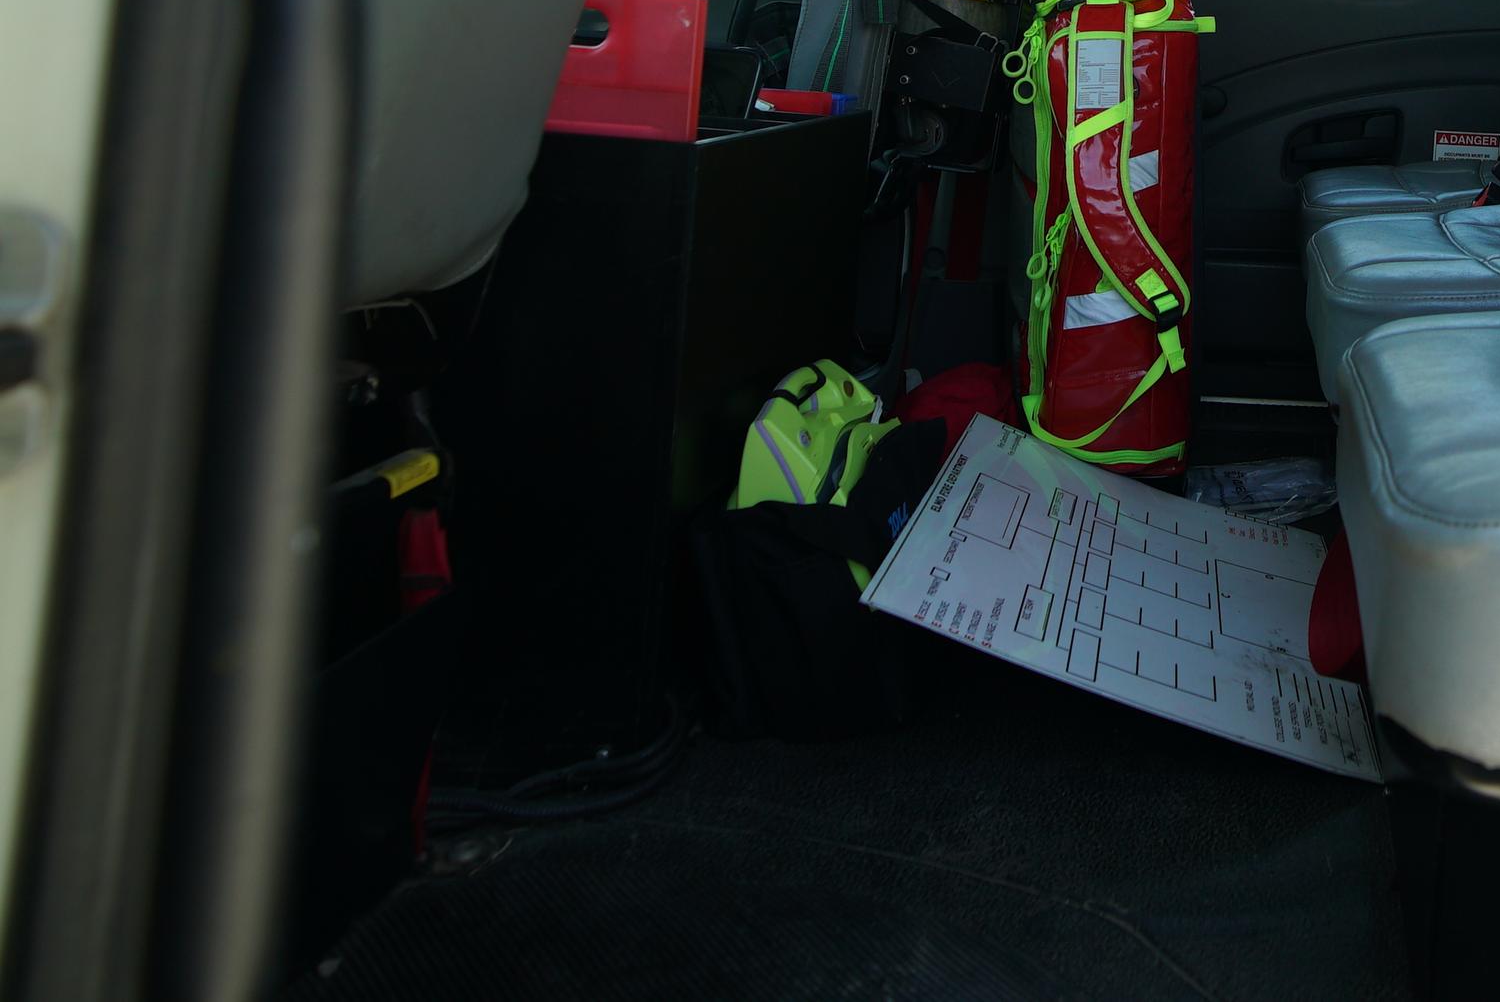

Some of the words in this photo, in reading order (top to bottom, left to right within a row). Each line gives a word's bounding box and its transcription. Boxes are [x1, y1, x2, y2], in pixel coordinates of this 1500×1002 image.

[1449, 135, 1498, 146] DANGER
[945, 453, 968, 486] DEPARTMENT
[939, 483, 952, 499] FIRE
[930, 496, 945, 513] ELMO
